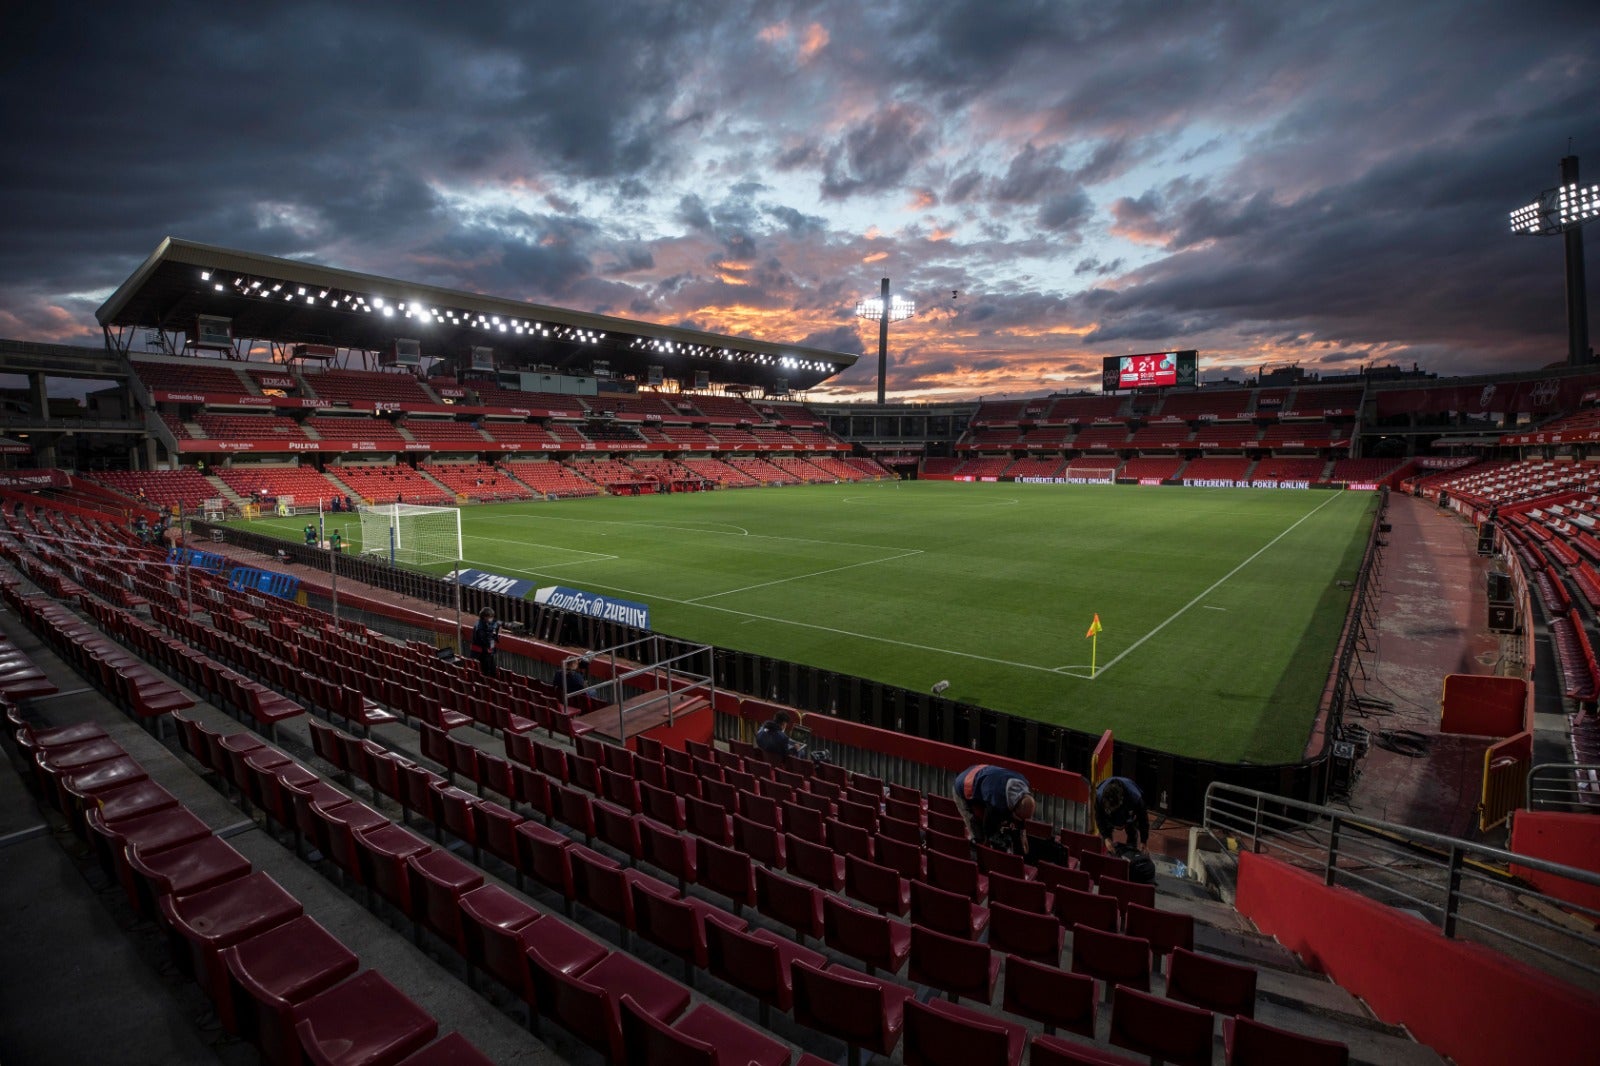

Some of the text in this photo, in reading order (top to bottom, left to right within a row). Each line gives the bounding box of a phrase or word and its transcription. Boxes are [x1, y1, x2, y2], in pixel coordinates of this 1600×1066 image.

[262, 377, 293, 387] IDEAL
[441, 389, 464, 397] IDEAL
[193, 394, 205, 402] Hoy
[302, 399, 332, 408] IDEAL
[1280, 481, 1310, 489] ONLINE
[548, 592, 647, 629] Allianz Seguros
